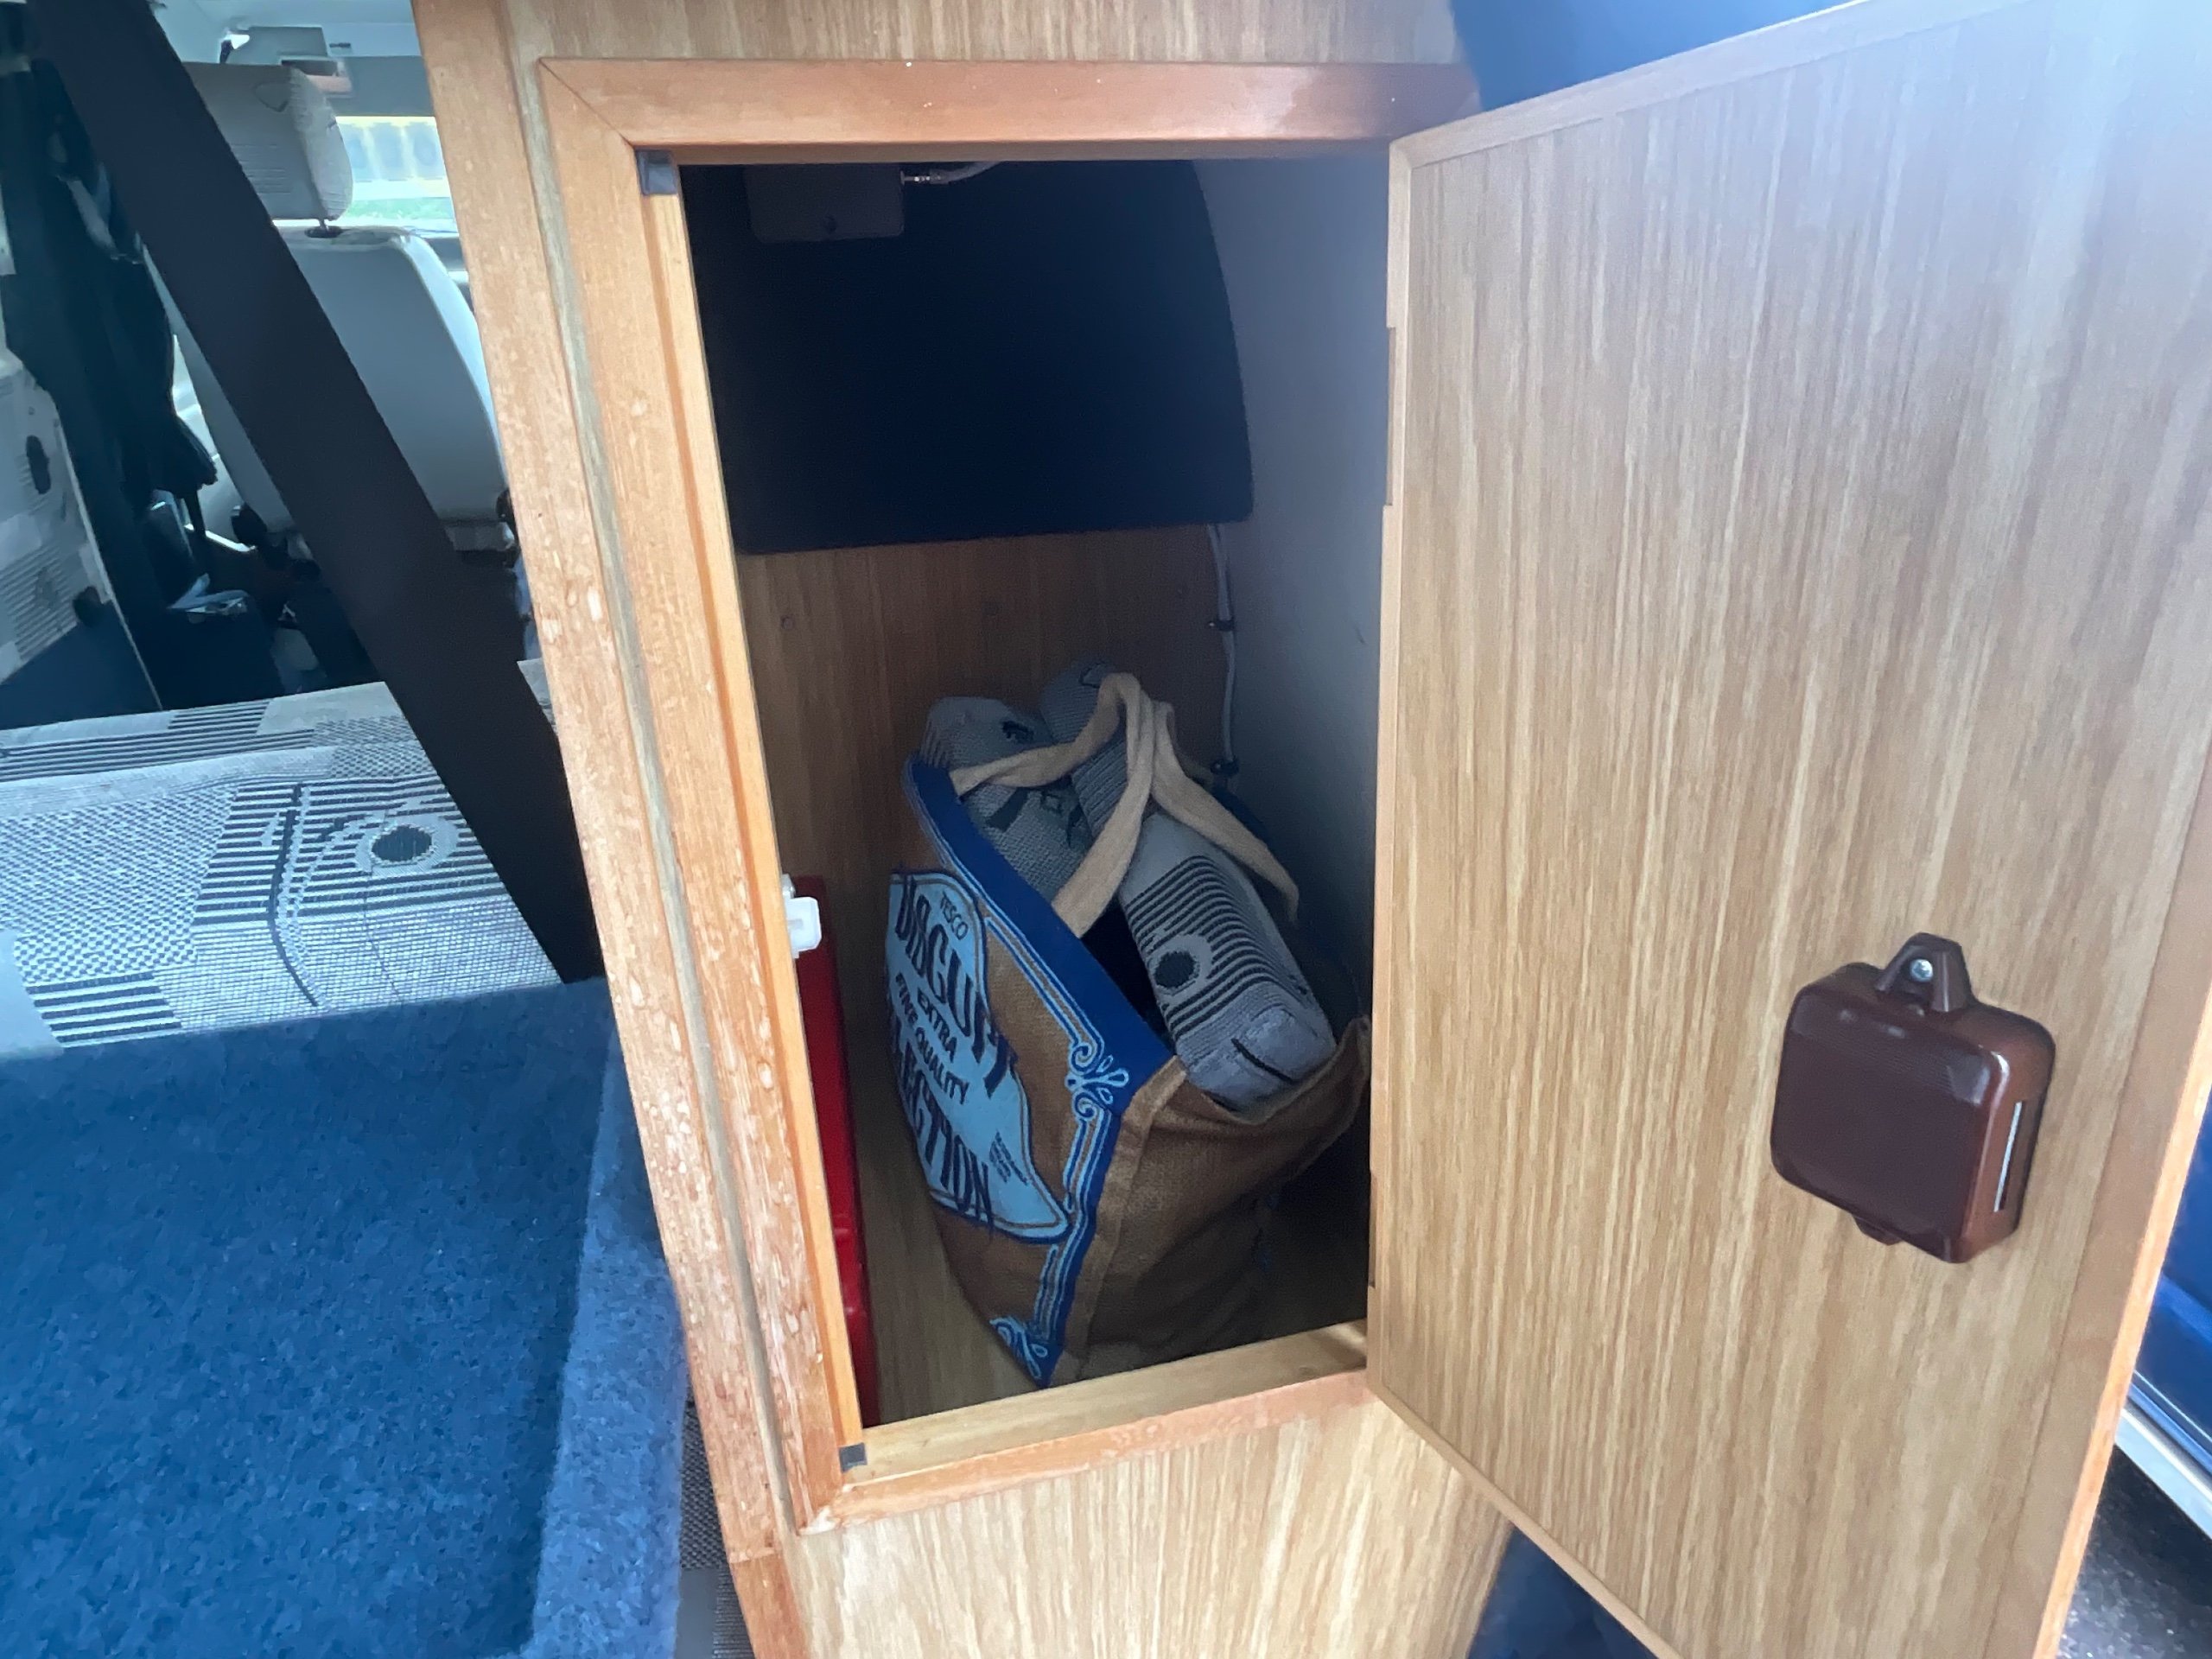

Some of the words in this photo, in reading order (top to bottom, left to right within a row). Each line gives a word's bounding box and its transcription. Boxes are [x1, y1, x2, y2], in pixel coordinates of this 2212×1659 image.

[939, 890, 969, 941] TESCO
[895, 971, 919, 1026] FINE
[914, 1027, 970, 1105] QUALITY
[917, 987, 958, 1064] EXTRA
